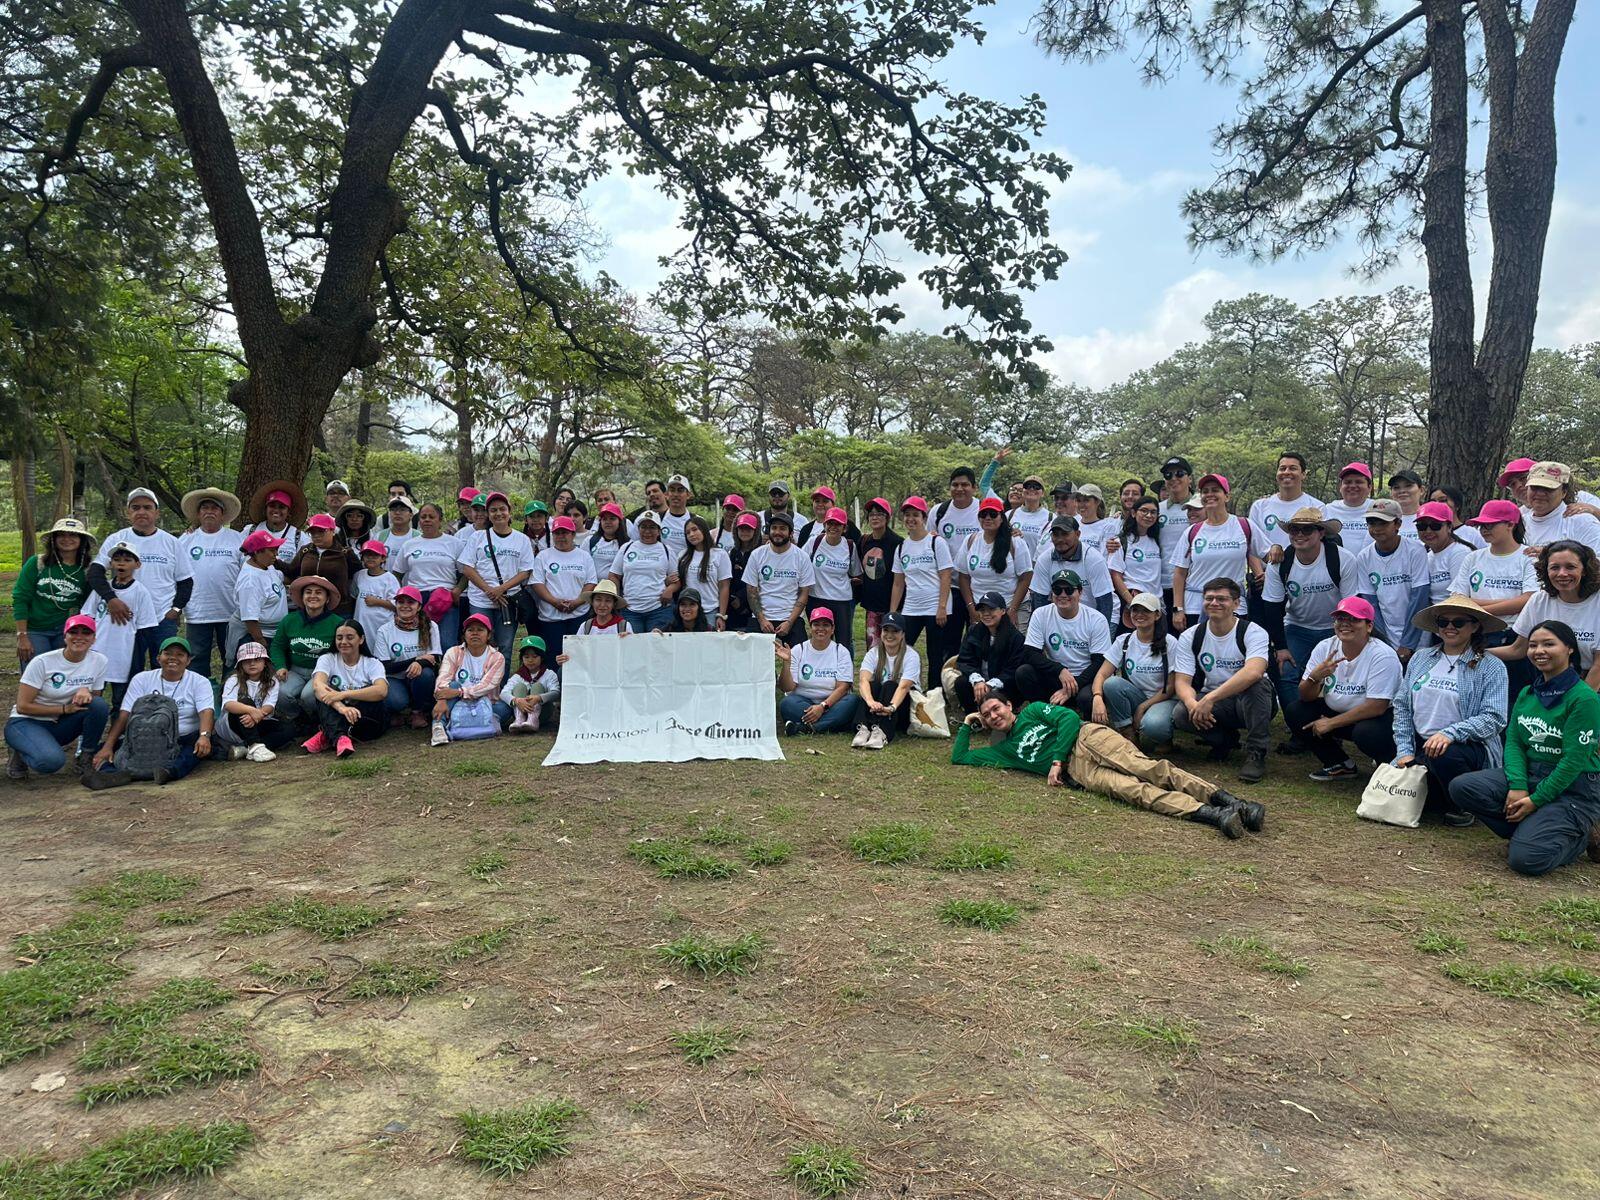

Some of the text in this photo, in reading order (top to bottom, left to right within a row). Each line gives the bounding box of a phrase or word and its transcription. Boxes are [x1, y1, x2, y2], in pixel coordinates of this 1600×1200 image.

[1383, 574, 1410, 583] CUERVOS
[1485, 578, 1523, 586] CUERVOS
[1303, 583, 1335, 592] CUERVOS
[1574, 631, 1595, 639] RVOS
[1430, 678, 1457, 687] CUERV
[1388, 784, 1417, 798] Cuervo
